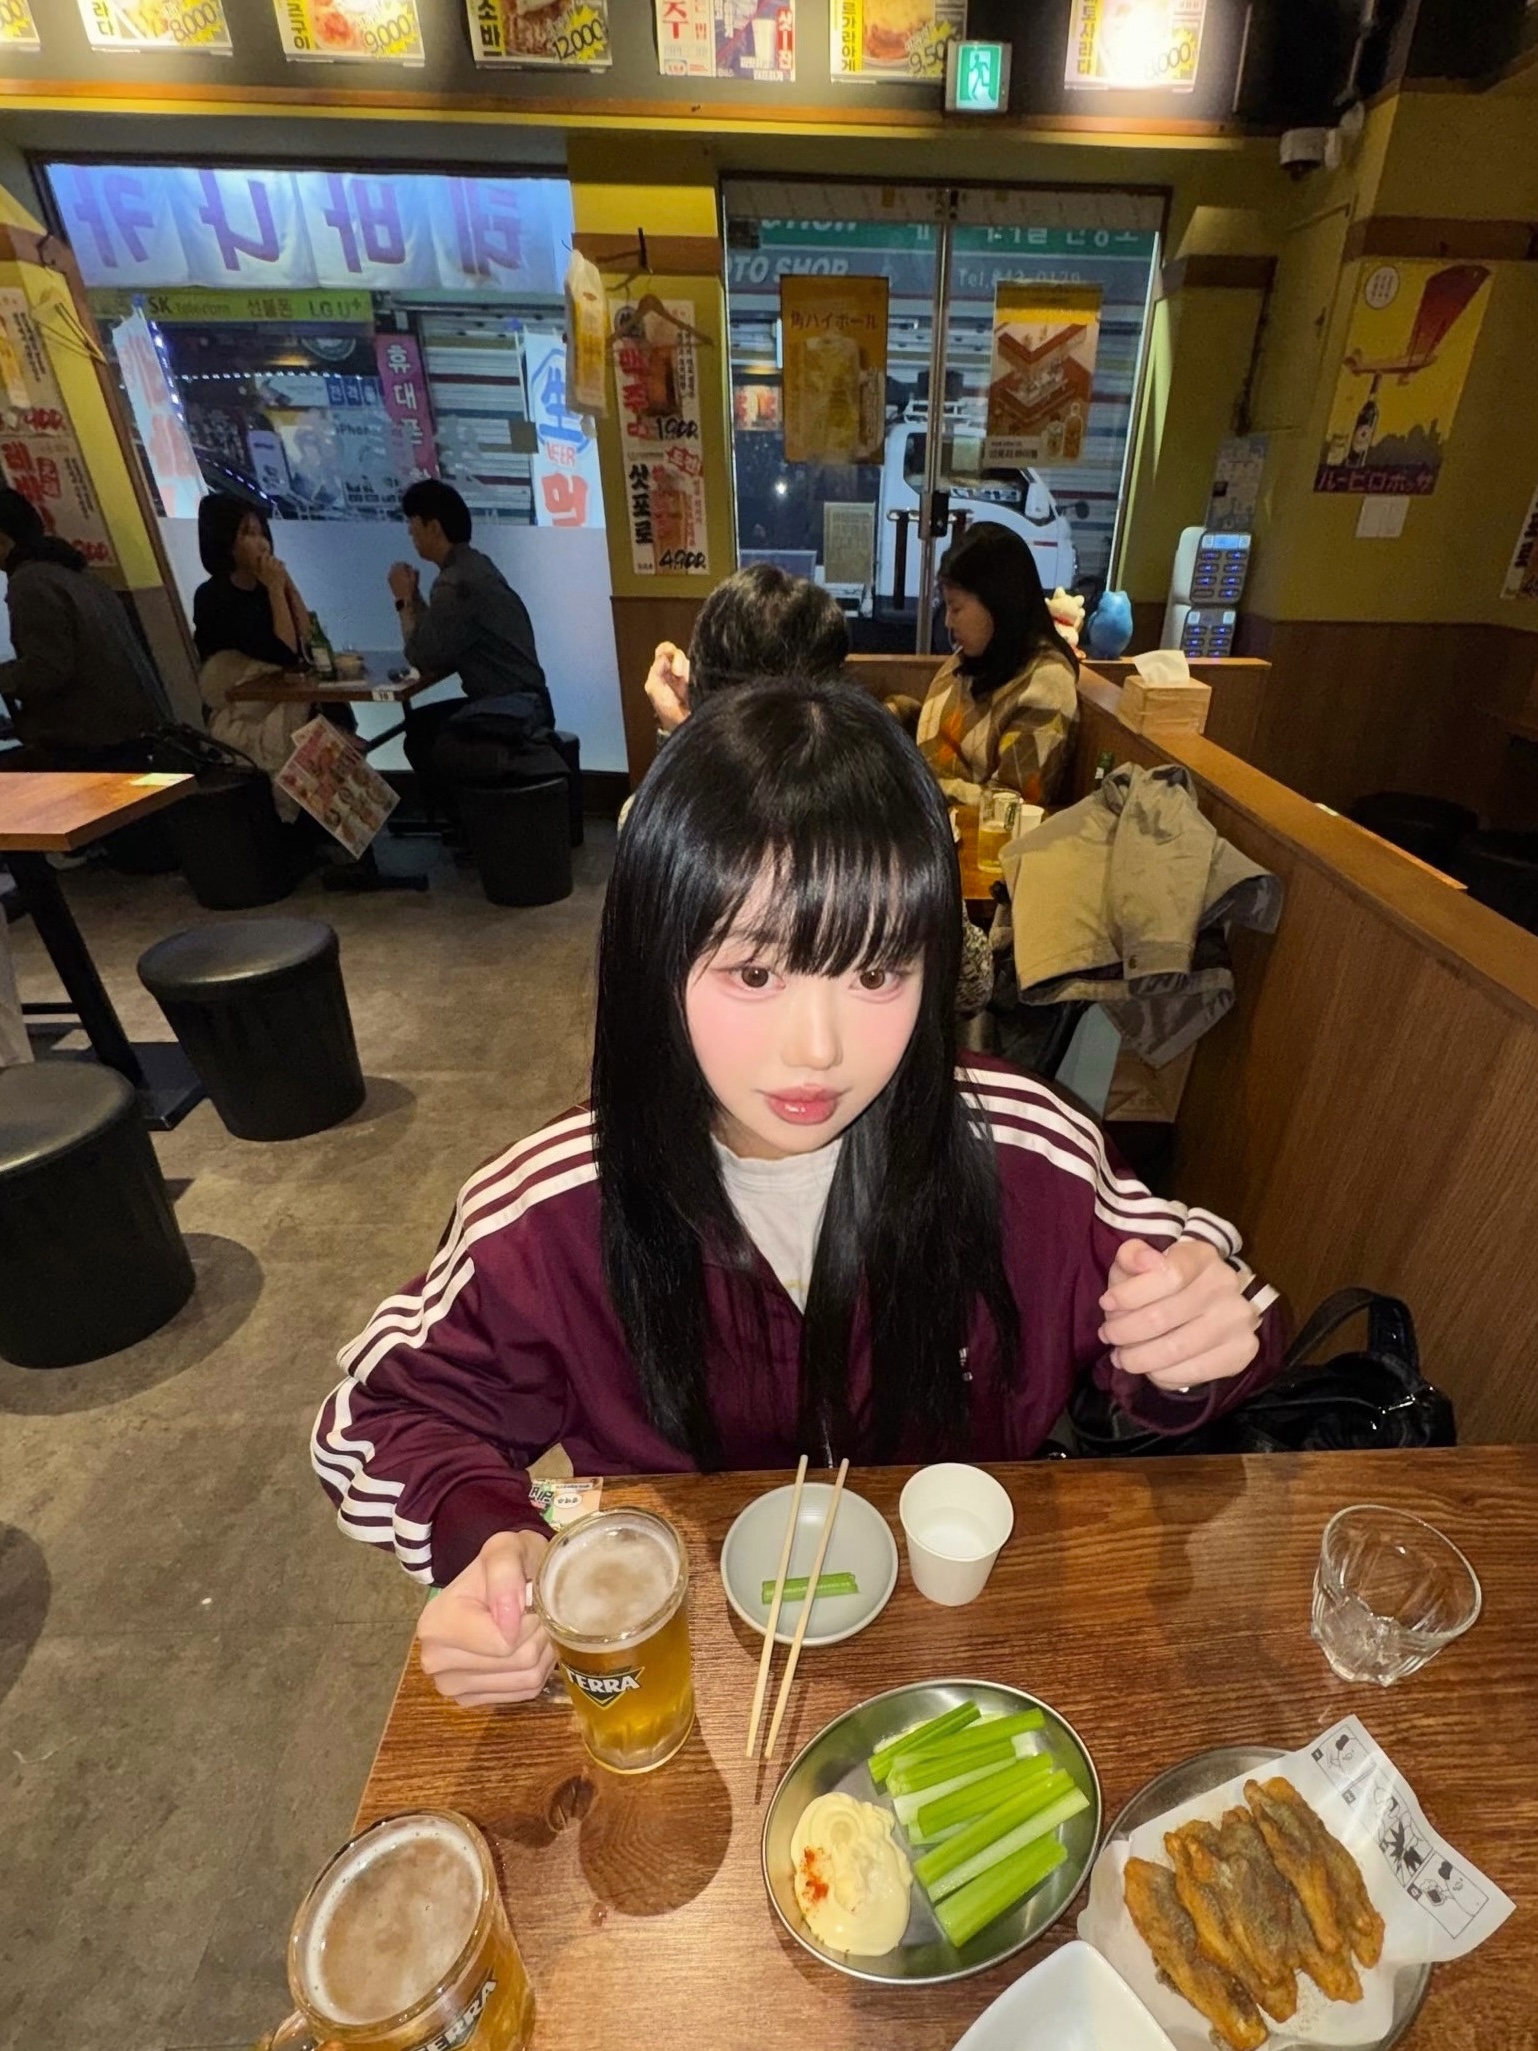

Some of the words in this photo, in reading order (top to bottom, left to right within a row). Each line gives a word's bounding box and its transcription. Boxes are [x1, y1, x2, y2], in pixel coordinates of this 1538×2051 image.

[169, 3, 218, 43] 8,000
[364, 14, 411, 54] 9,000
[553, 18, 603, 61] 12,000
[909, 34, 958, 75] 9,50
[628, 464, 654, 545] 삿포로
[566, 1668, 641, 1694] TERRA
